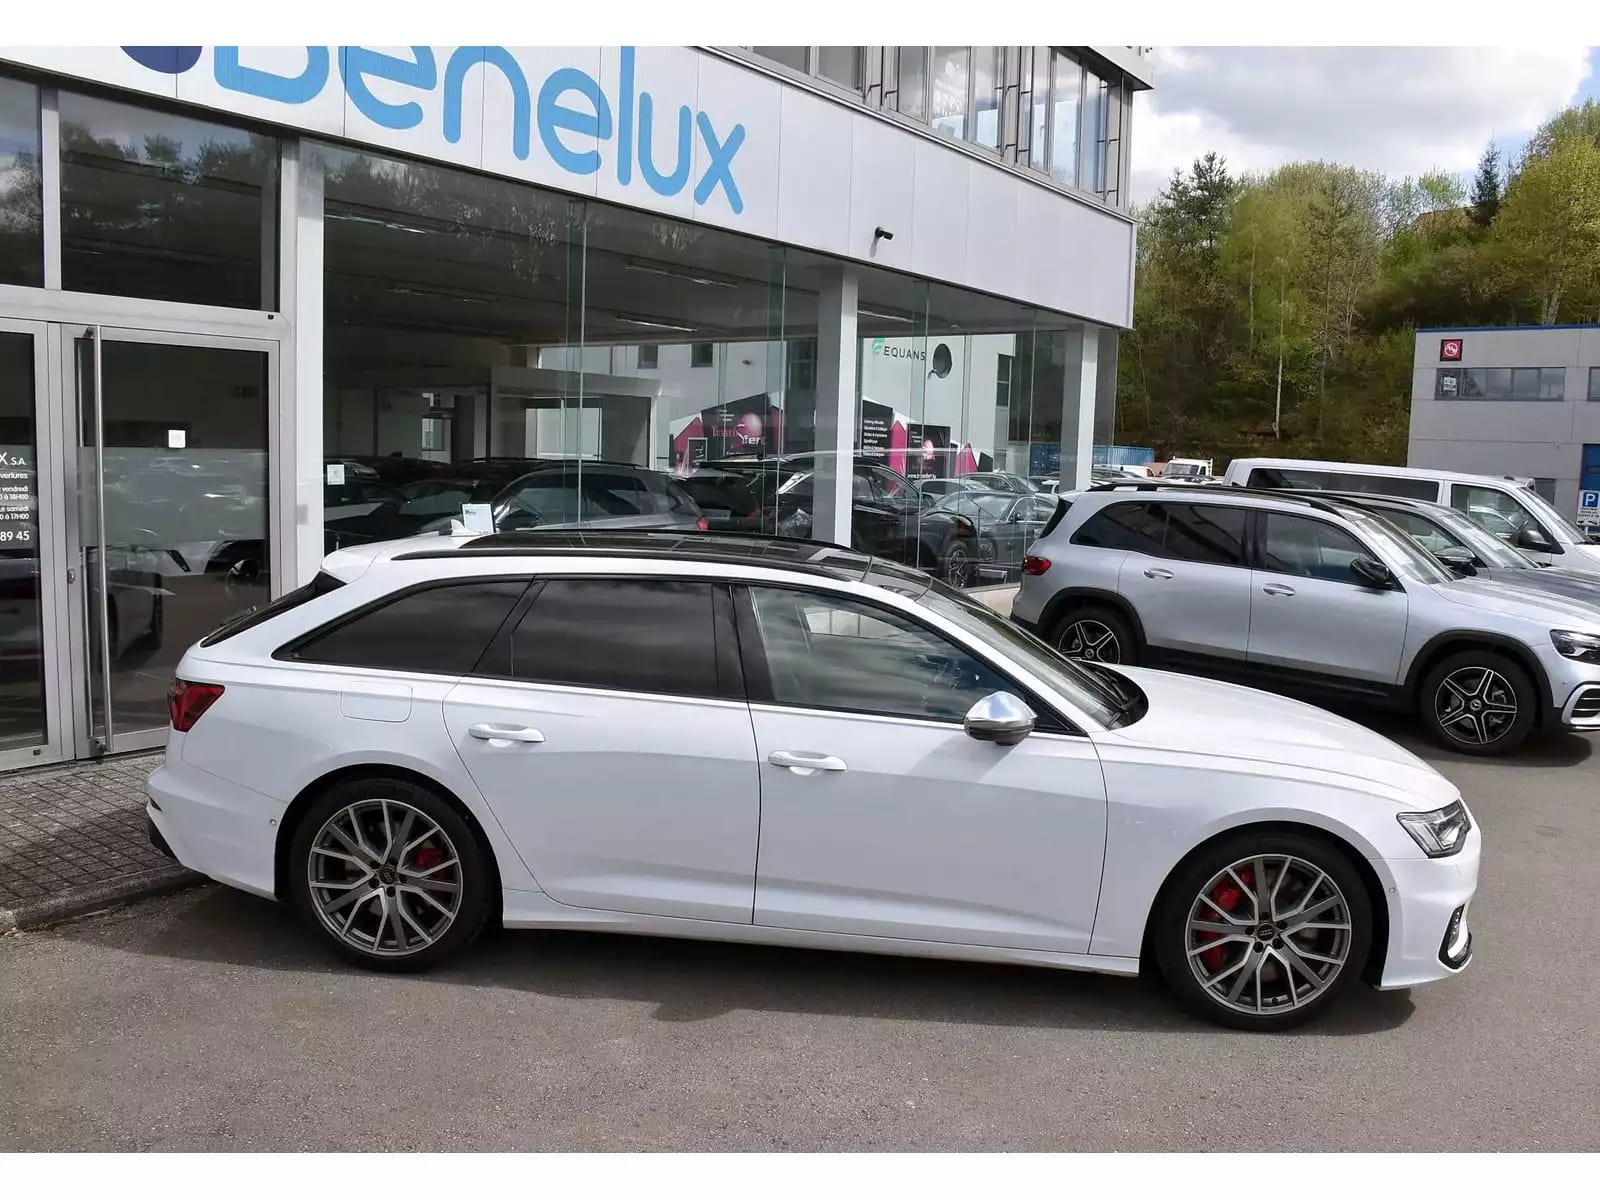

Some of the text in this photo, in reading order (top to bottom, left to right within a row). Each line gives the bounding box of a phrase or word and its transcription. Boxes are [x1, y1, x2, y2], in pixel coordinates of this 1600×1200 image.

[883, 345, 926, 361] EQUANS
[1585, 493, 1596, 506] P
[0, 530, 30, 542] 89 45
